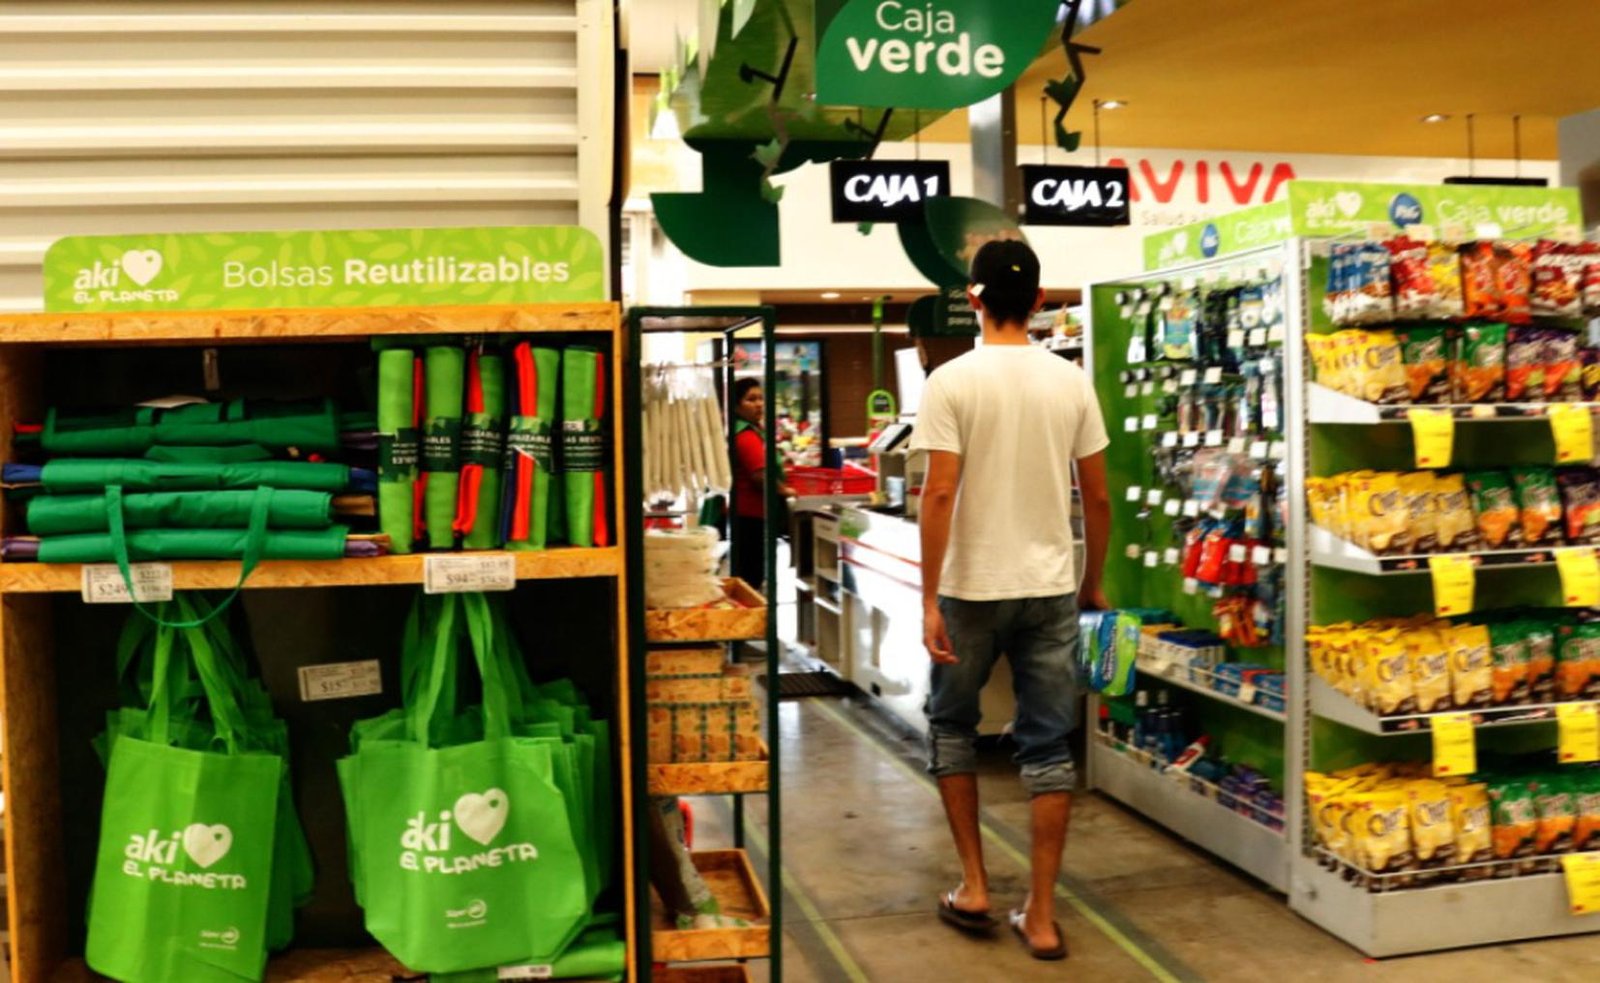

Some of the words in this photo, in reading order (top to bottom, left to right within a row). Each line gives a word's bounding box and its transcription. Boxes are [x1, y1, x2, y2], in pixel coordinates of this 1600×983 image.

[876, 1, 955, 38] Caja
[846, 32, 1005, 78] verde
[844, 174, 920, 207] CAJA
[923, 175, 939, 197] 1
[1031, 178, 1103, 211] CAJA
[1104, 180, 1125, 207] 2
[1436, 200, 1490, 226] Caja
[1496, 202, 1569, 224] verde
[73, 259, 120, 290] aki
[223, 260, 333, 288] Bolsas
[344, 256, 570, 285] Reutilizables
[100, 289, 179, 303] PLANETA
[124, 829, 182, 864] aki
[400, 810, 452, 852] aki
[400, 851, 419, 870] EL
[423, 842, 539, 874] PLANETA
[123, 860, 144, 878] EL
[148, 866, 247, 889] PLANETA
